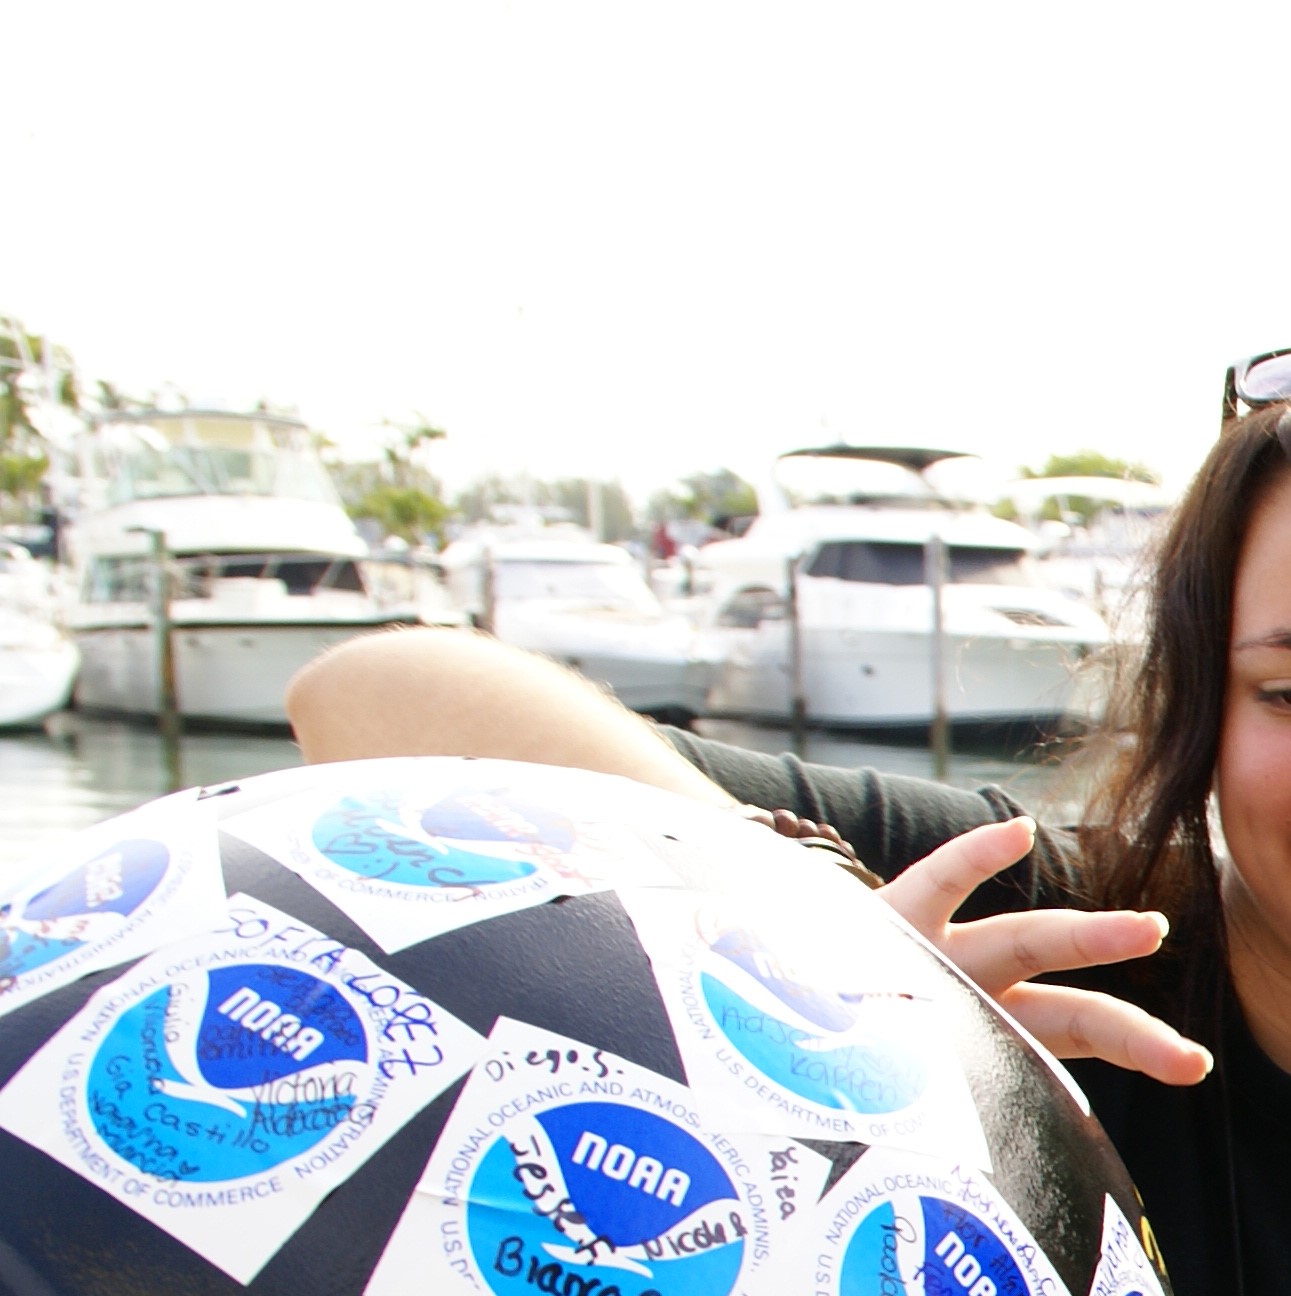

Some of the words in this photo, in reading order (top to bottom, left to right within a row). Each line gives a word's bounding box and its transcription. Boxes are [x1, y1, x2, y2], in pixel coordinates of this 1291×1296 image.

[81, 976, 158, 1042] NATIONAL
[165, 945, 260, 979] OCEANIC
[217, 986, 325, 1062] NOAA
[743, 1076, 857, 1133] DEPARTMEN
[442, 1127, 495, 1208] NATIONAL
[487, 1081, 575, 1128] OCEANIC
[578, 1080, 625, 1097] AND
[630, 1086, 751, 1180] ATMOSHERIC
[571, 1130, 693, 1208] NOAA
[122, 1177, 151, 1196] OF
[153, 1175, 284, 1209] COMMERCE
[825, 1184, 884, 1246] NATIONAL
[883, 1173, 953, 1195] OCEANIC
